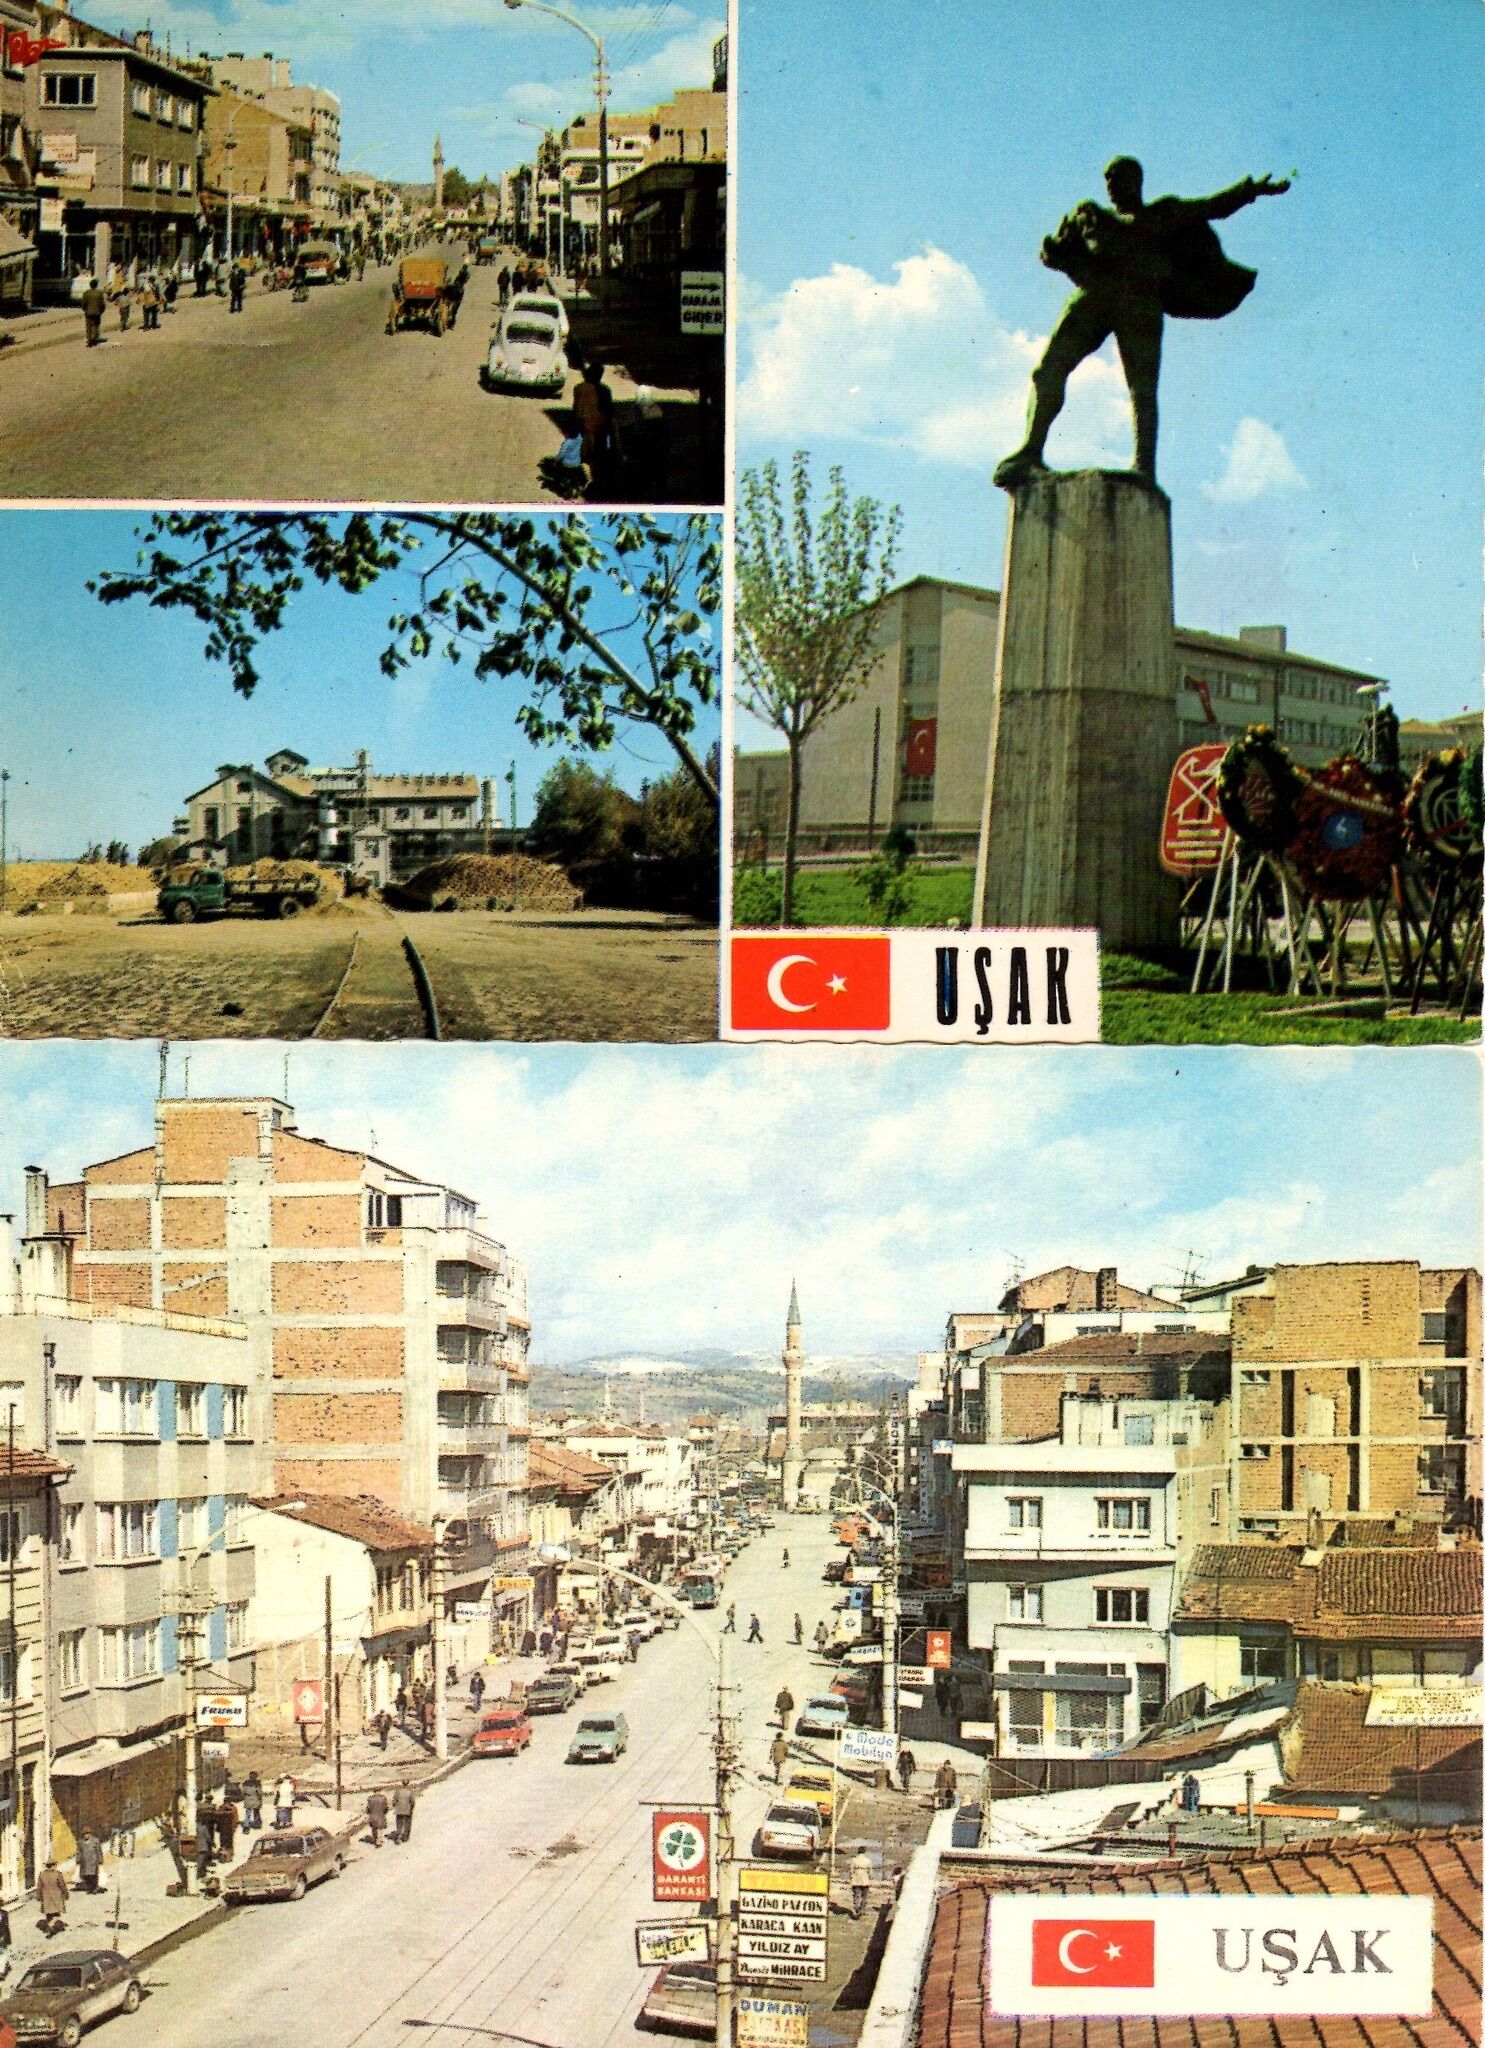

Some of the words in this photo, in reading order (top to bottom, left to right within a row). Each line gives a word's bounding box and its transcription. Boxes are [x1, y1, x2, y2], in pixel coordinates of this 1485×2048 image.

[656, 1886, 706, 1896] BANKASI
[740, 1919, 785, 1931] KARACA
[793, 1921, 822, 1934] KAAN
[794, 1944, 810, 1955] AY
[740, 1999, 807, 2017] DUMAN
